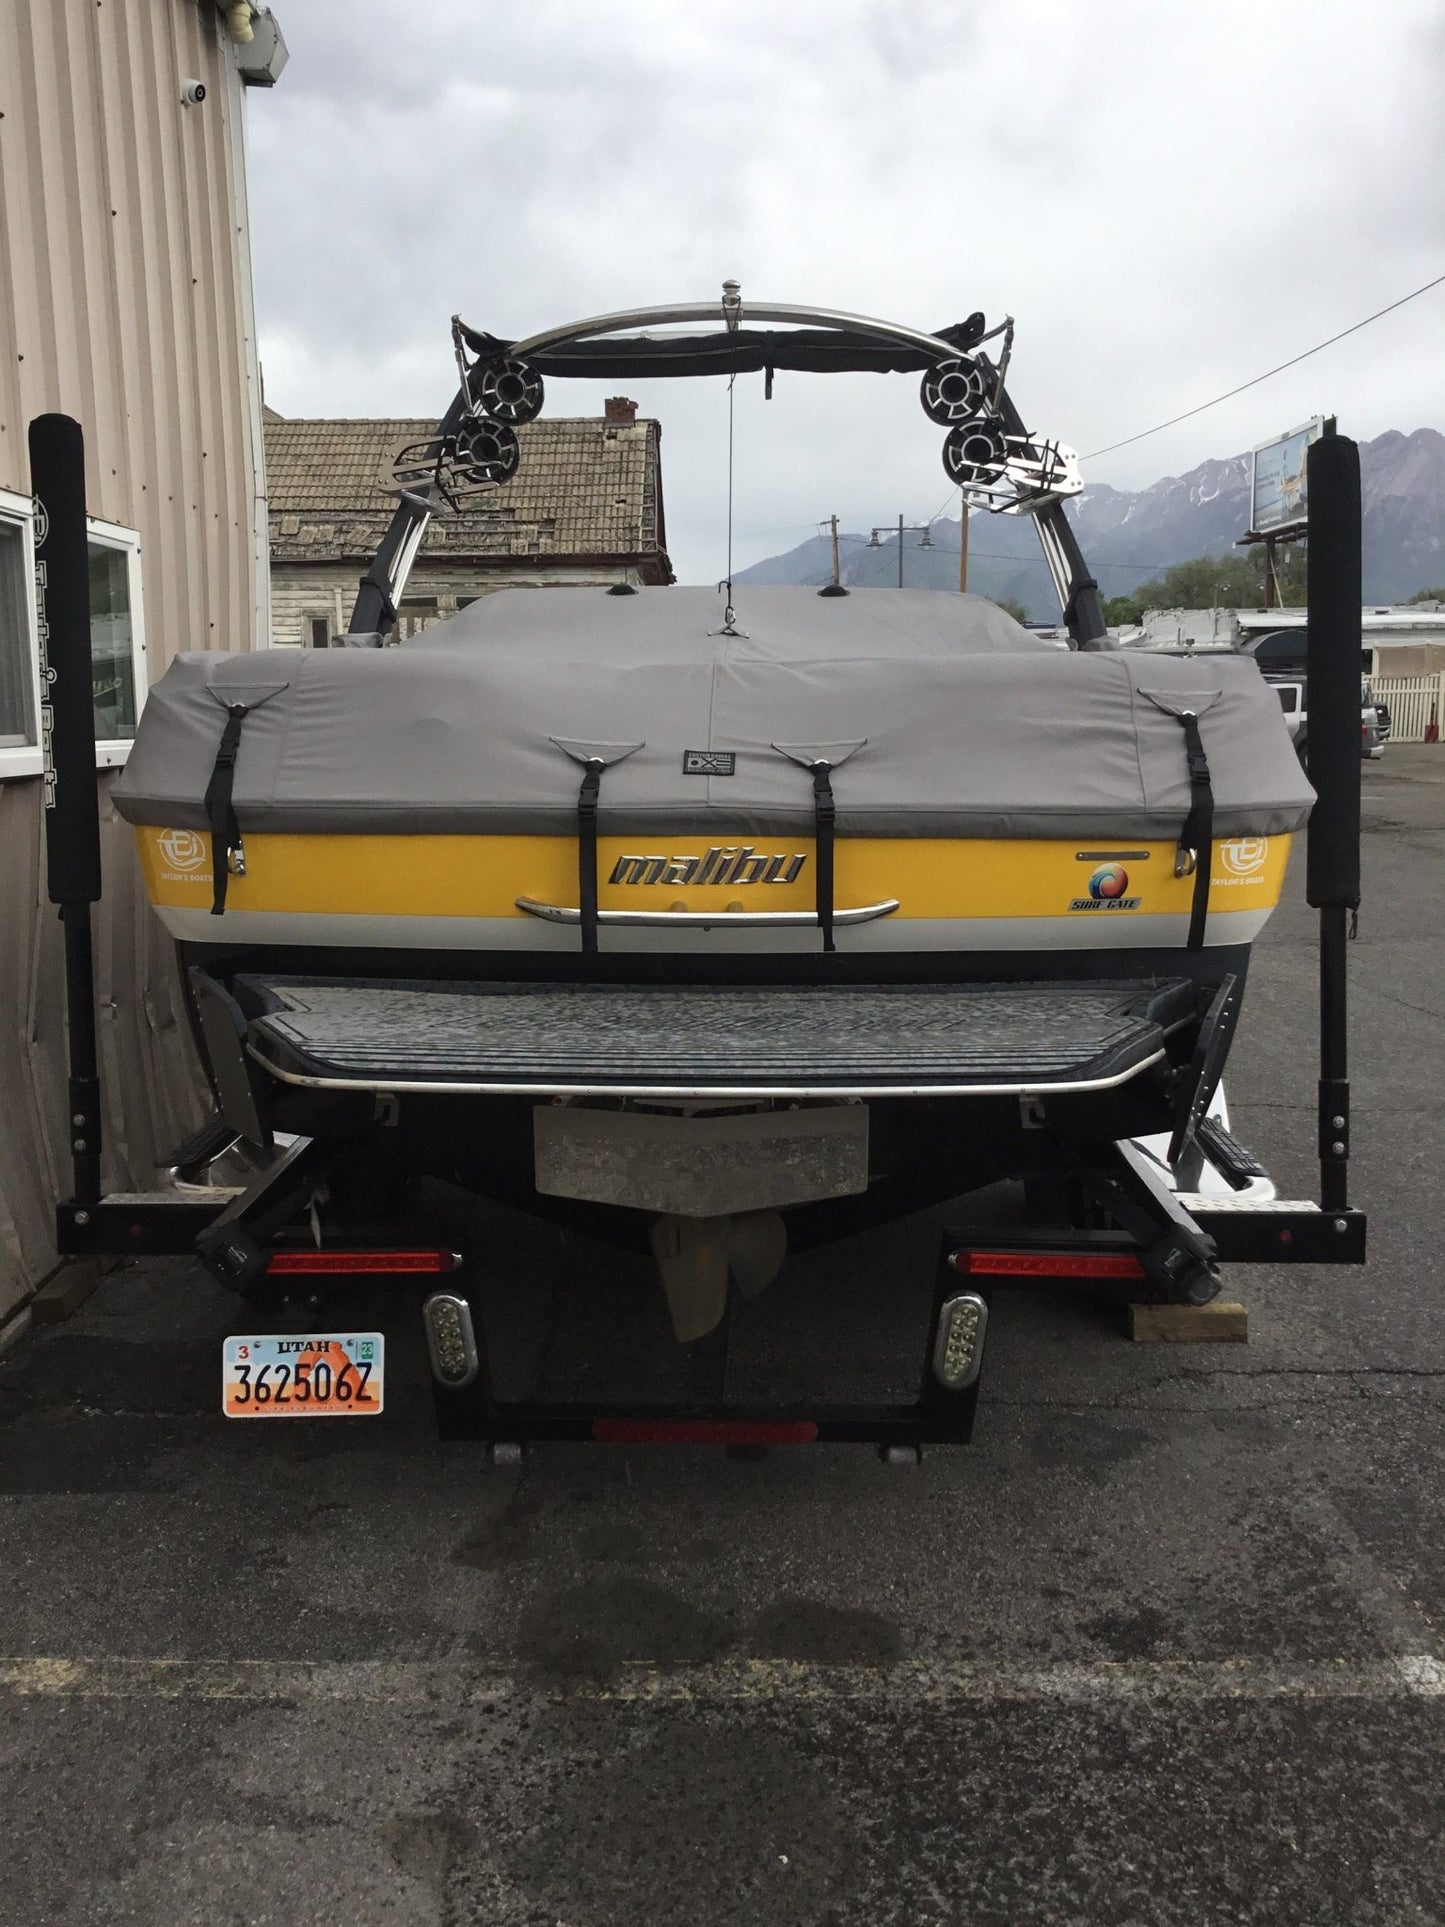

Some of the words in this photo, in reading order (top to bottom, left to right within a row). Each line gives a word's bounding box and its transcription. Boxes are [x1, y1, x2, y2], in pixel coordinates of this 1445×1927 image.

[608, 846, 807, 885] malibu
[1072, 900, 1101, 910] SURF
[1106, 899, 1139, 909] GATE
[238, 1346, 249, 1359] 3
[277, 1341, 331, 1354] UTAH
[361, 1343, 373, 1355] 23
[234, 1362, 373, 1403] 362506Z
